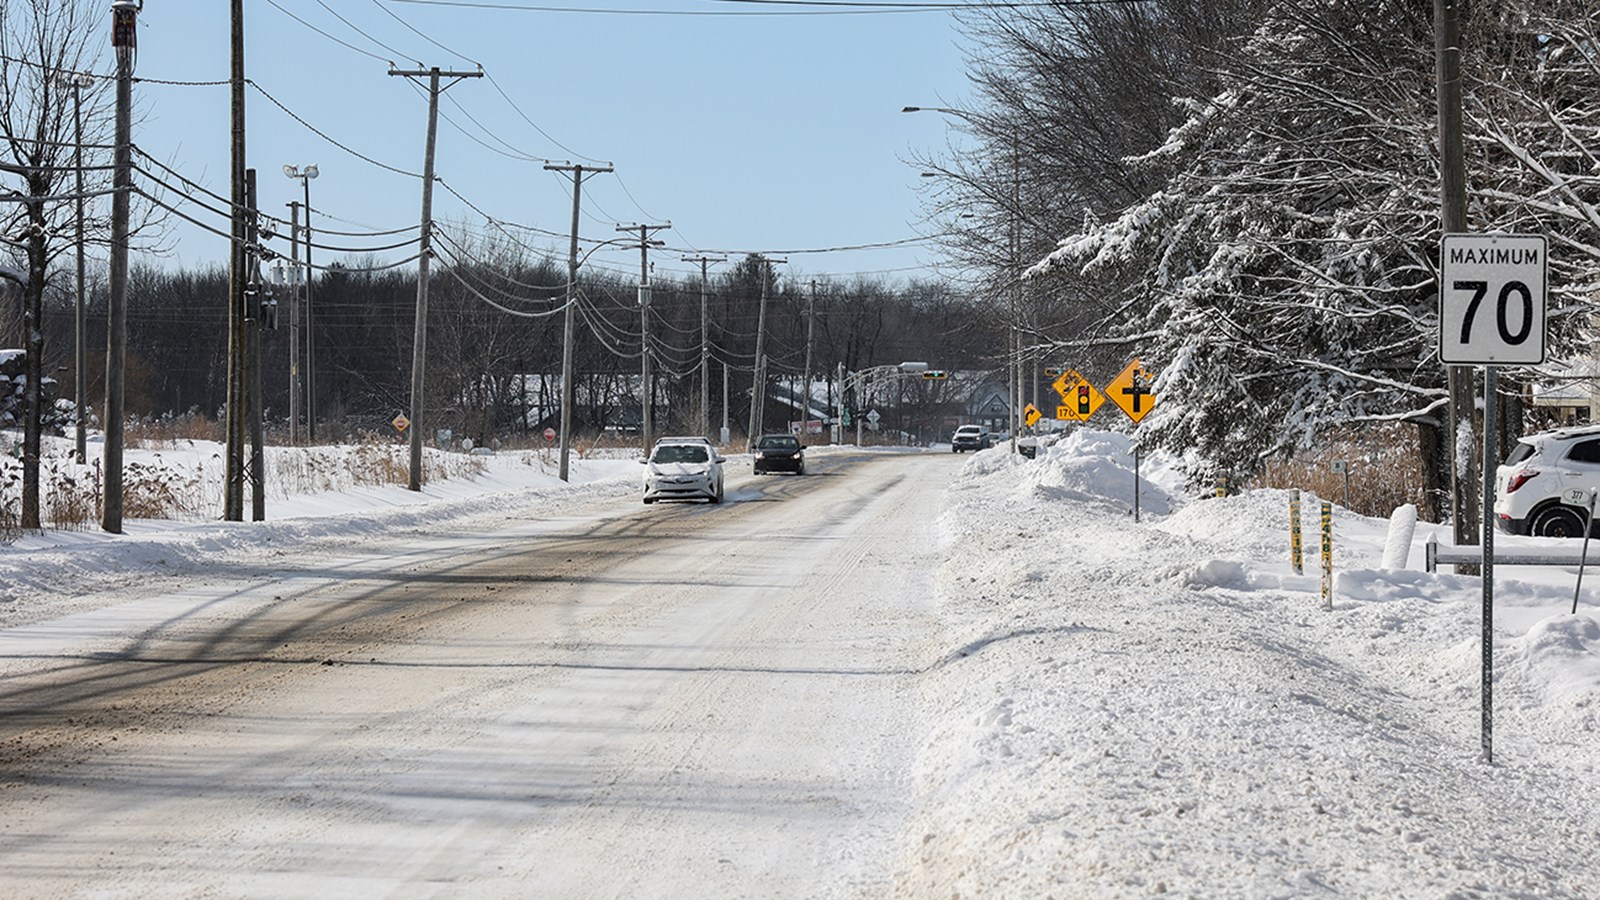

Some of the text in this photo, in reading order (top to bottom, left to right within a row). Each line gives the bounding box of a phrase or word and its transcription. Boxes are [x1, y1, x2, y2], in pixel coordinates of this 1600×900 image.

[1450, 248, 1538, 265] MAXIMUM
[1453, 280, 1533, 345] 70
[1572, 490, 1583, 499] 377
